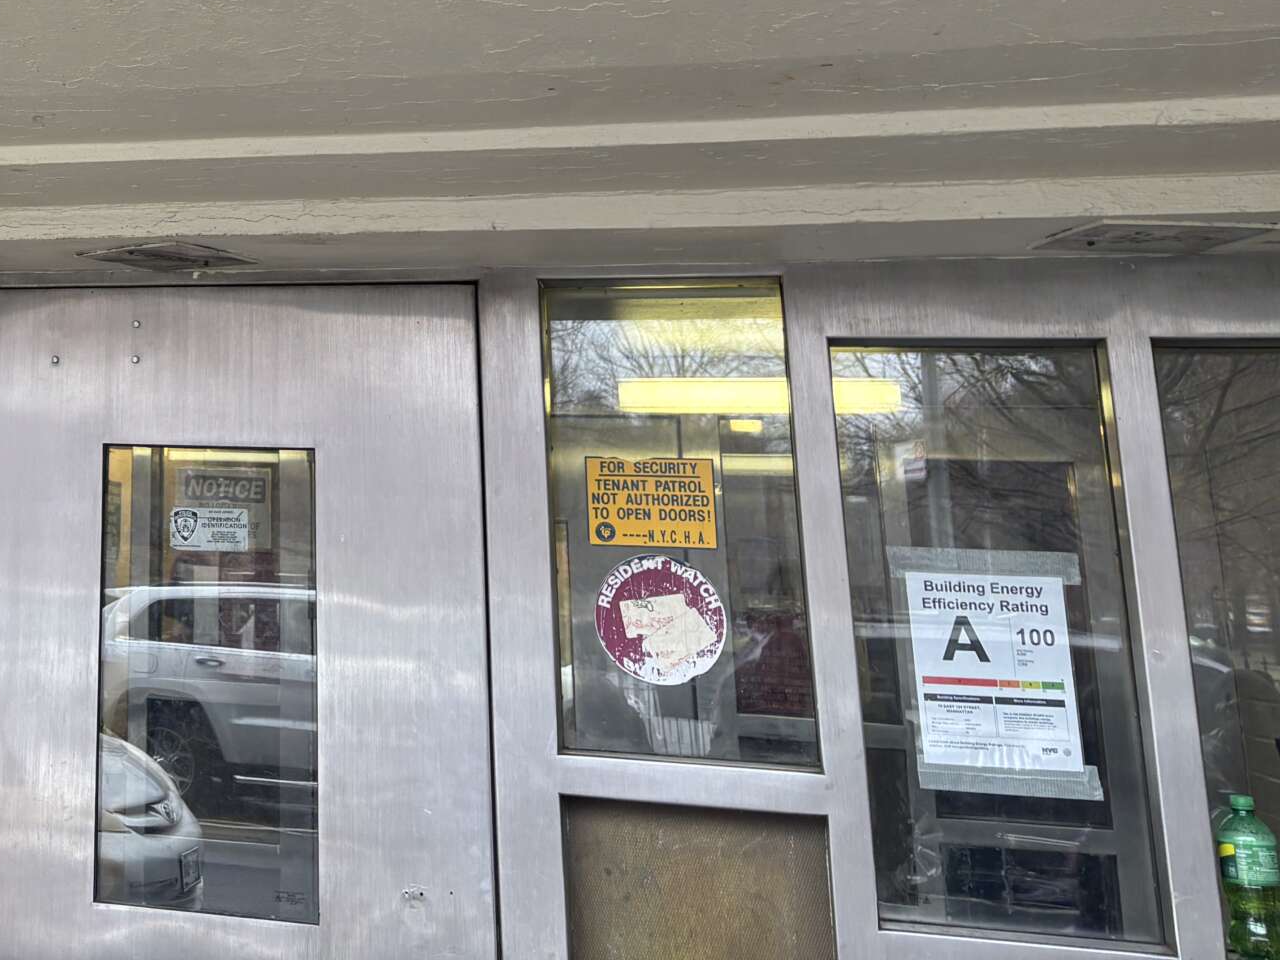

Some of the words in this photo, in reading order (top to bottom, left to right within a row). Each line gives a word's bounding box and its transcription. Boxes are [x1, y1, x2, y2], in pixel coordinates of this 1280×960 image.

[600, 461, 625, 474] FOR
[634, 461, 698, 475] SECURITY
[595, 479, 648, 492] TENANT
[655, 480, 706, 493] PATROL
[592, 492, 618, 505] NOT
[626, 493, 710, 507] AUTHORIZED
[592, 507, 610, 520] TO
[617, 508, 651, 521] OPEN
[659, 510, 711, 522] DOORS!
[201, 522, 247, 530] IDENTIFICATION
[598, 557, 665, 608] RESIDENT
[670, 560, 721, 608] WATCH
[923, 580, 985, 596] Building
[990, 582, 1043, 598] Energy
[922, 597, 994, 614] Efficiency
[1000, 600, 1049, 616] Rating
[942, 615, 991, 663] A
[1016, 628, 1055, 647] 100
